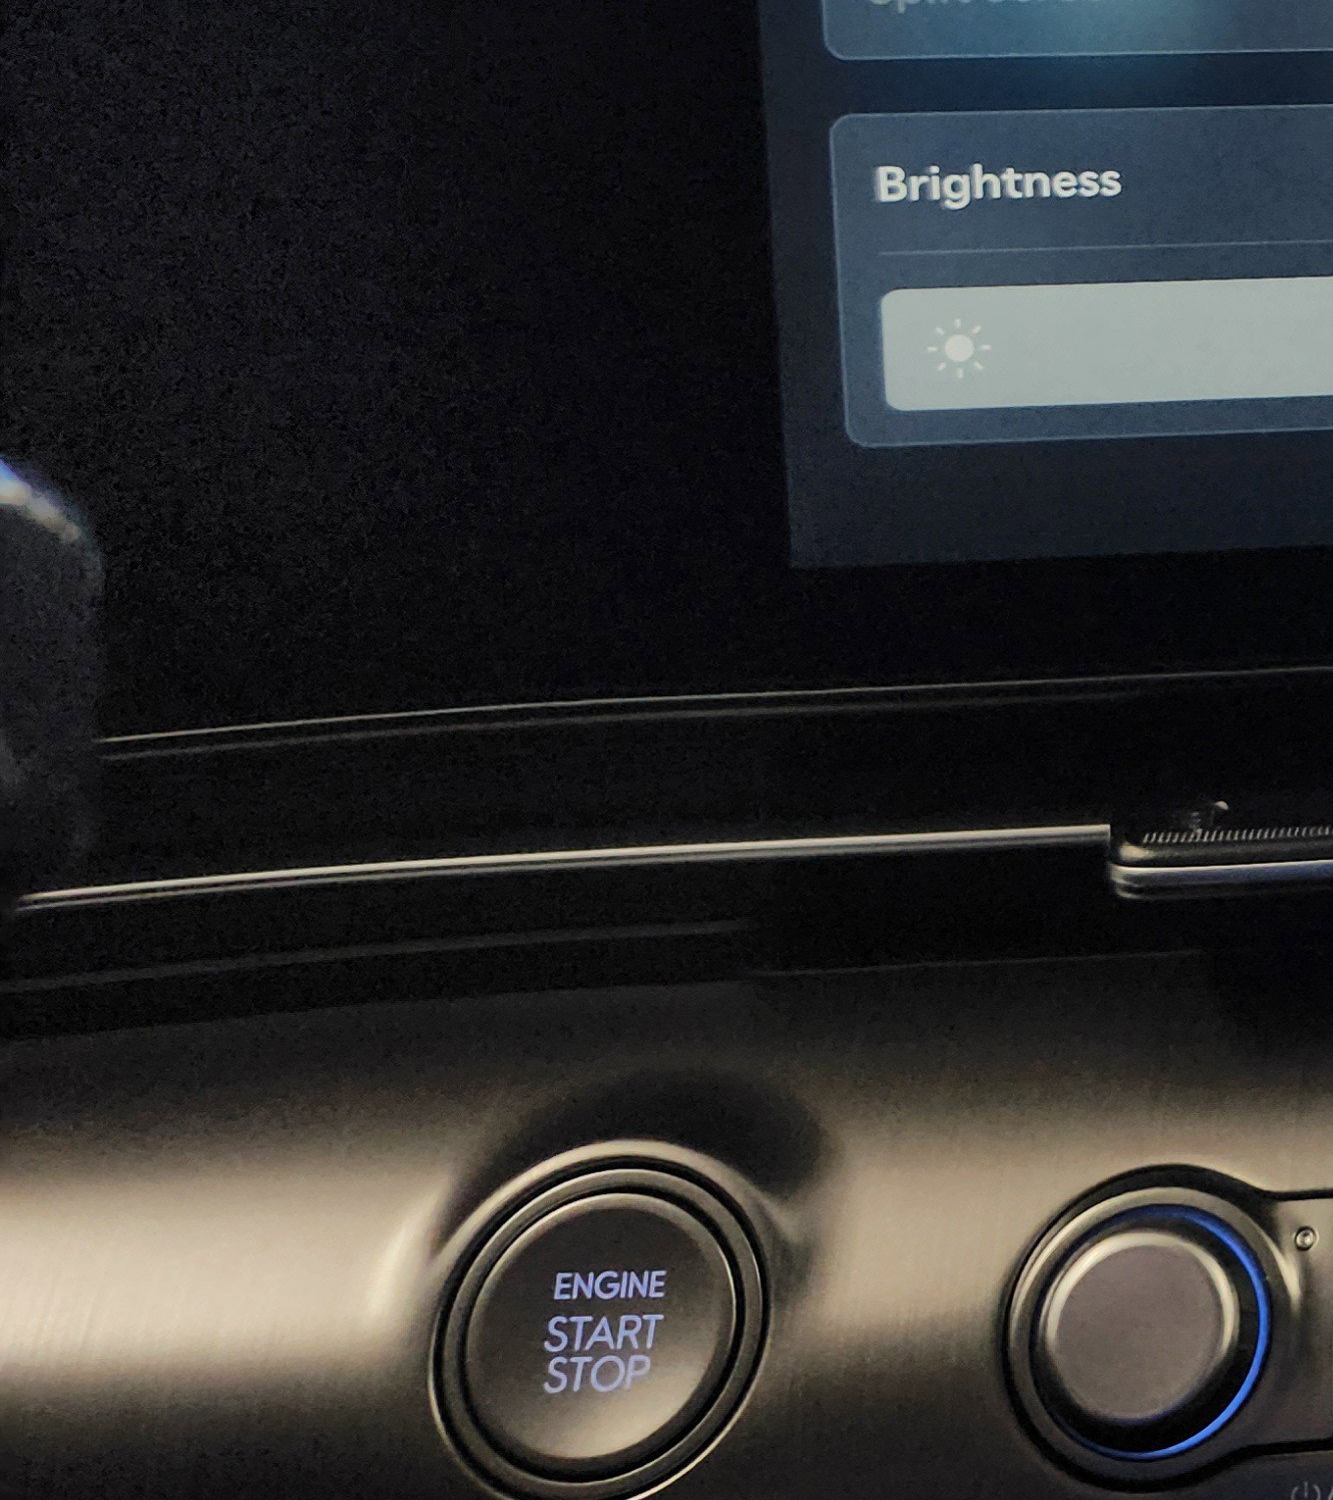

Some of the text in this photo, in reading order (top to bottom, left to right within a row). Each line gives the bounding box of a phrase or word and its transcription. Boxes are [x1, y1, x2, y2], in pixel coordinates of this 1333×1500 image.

[875, 164, 1122, 211] Brightness
[553, 1269, 668, 1301] ENGINE
[543, 1314, 664, 1353] START
[543, 1355, 651, 1393] STOP
